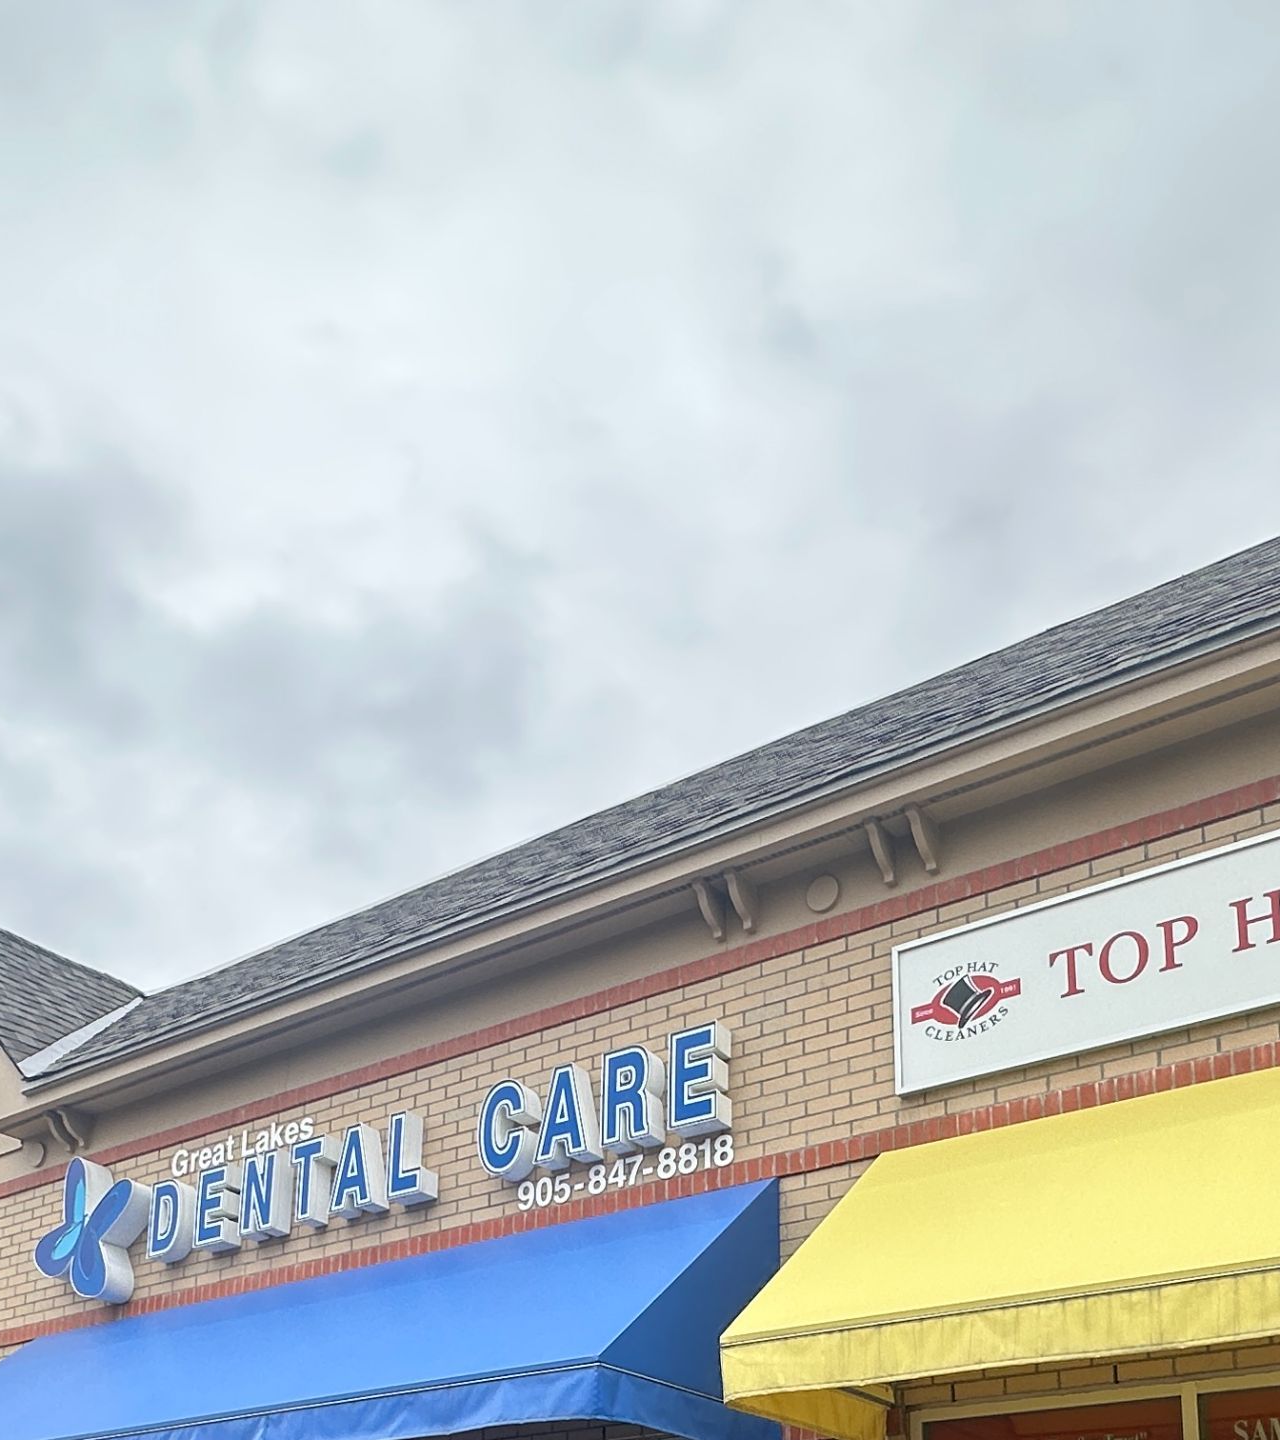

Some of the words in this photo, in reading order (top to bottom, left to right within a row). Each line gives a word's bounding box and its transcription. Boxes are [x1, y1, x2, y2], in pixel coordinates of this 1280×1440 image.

[932, 965, 964, 987] TOP
[966, 961, 1000, 974] HAT
[1049, 914, 1200, 1000] TOP
[924, 1005, 1009, 1042] CLEANERS
[145, 1110, 438, 1264] DENTAL
[477, 1018, 733, 1182] CARE
[171, 1137, 235, 1178] Great
[241, 1117, 315, 1159] Lakes
[517, 1135, 735, 1212] 905-847-8818
